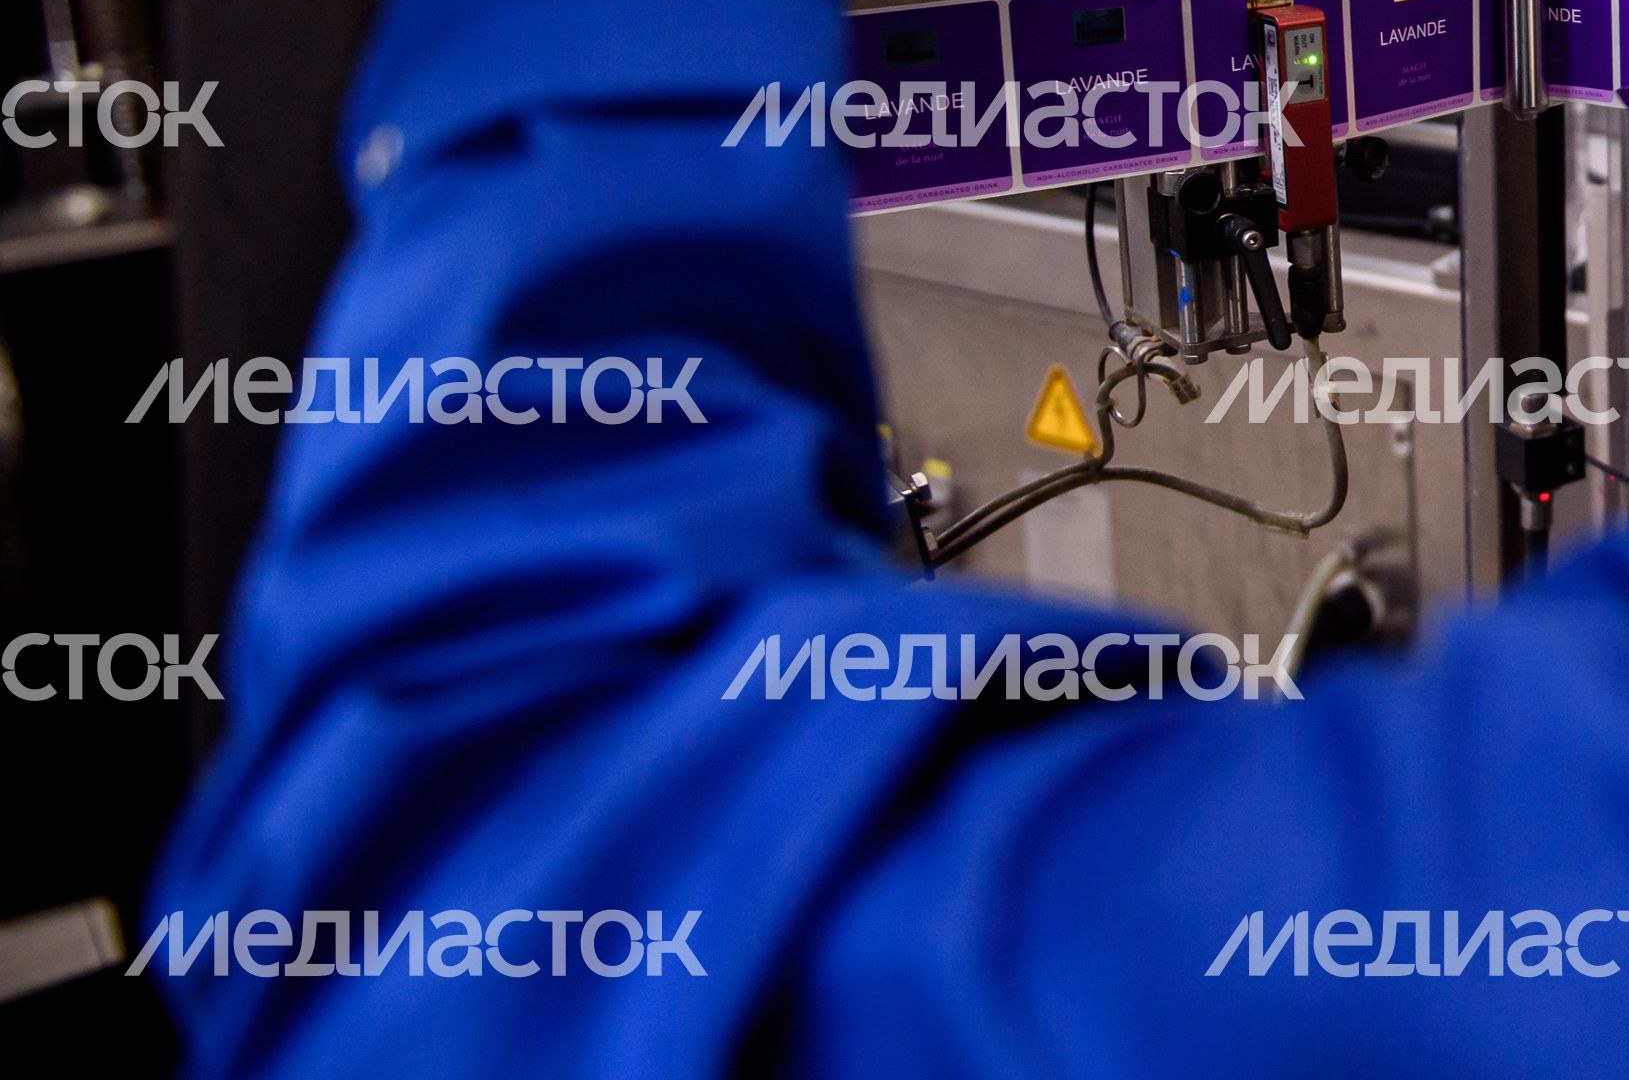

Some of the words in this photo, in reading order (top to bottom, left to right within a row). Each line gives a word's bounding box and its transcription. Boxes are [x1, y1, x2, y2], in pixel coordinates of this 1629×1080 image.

[1380, 19, 1447, 46] LAVANDE
[1055, 68, 1149, 96] LAVANDE
[864, 92, 965, 120] LAVANDE
